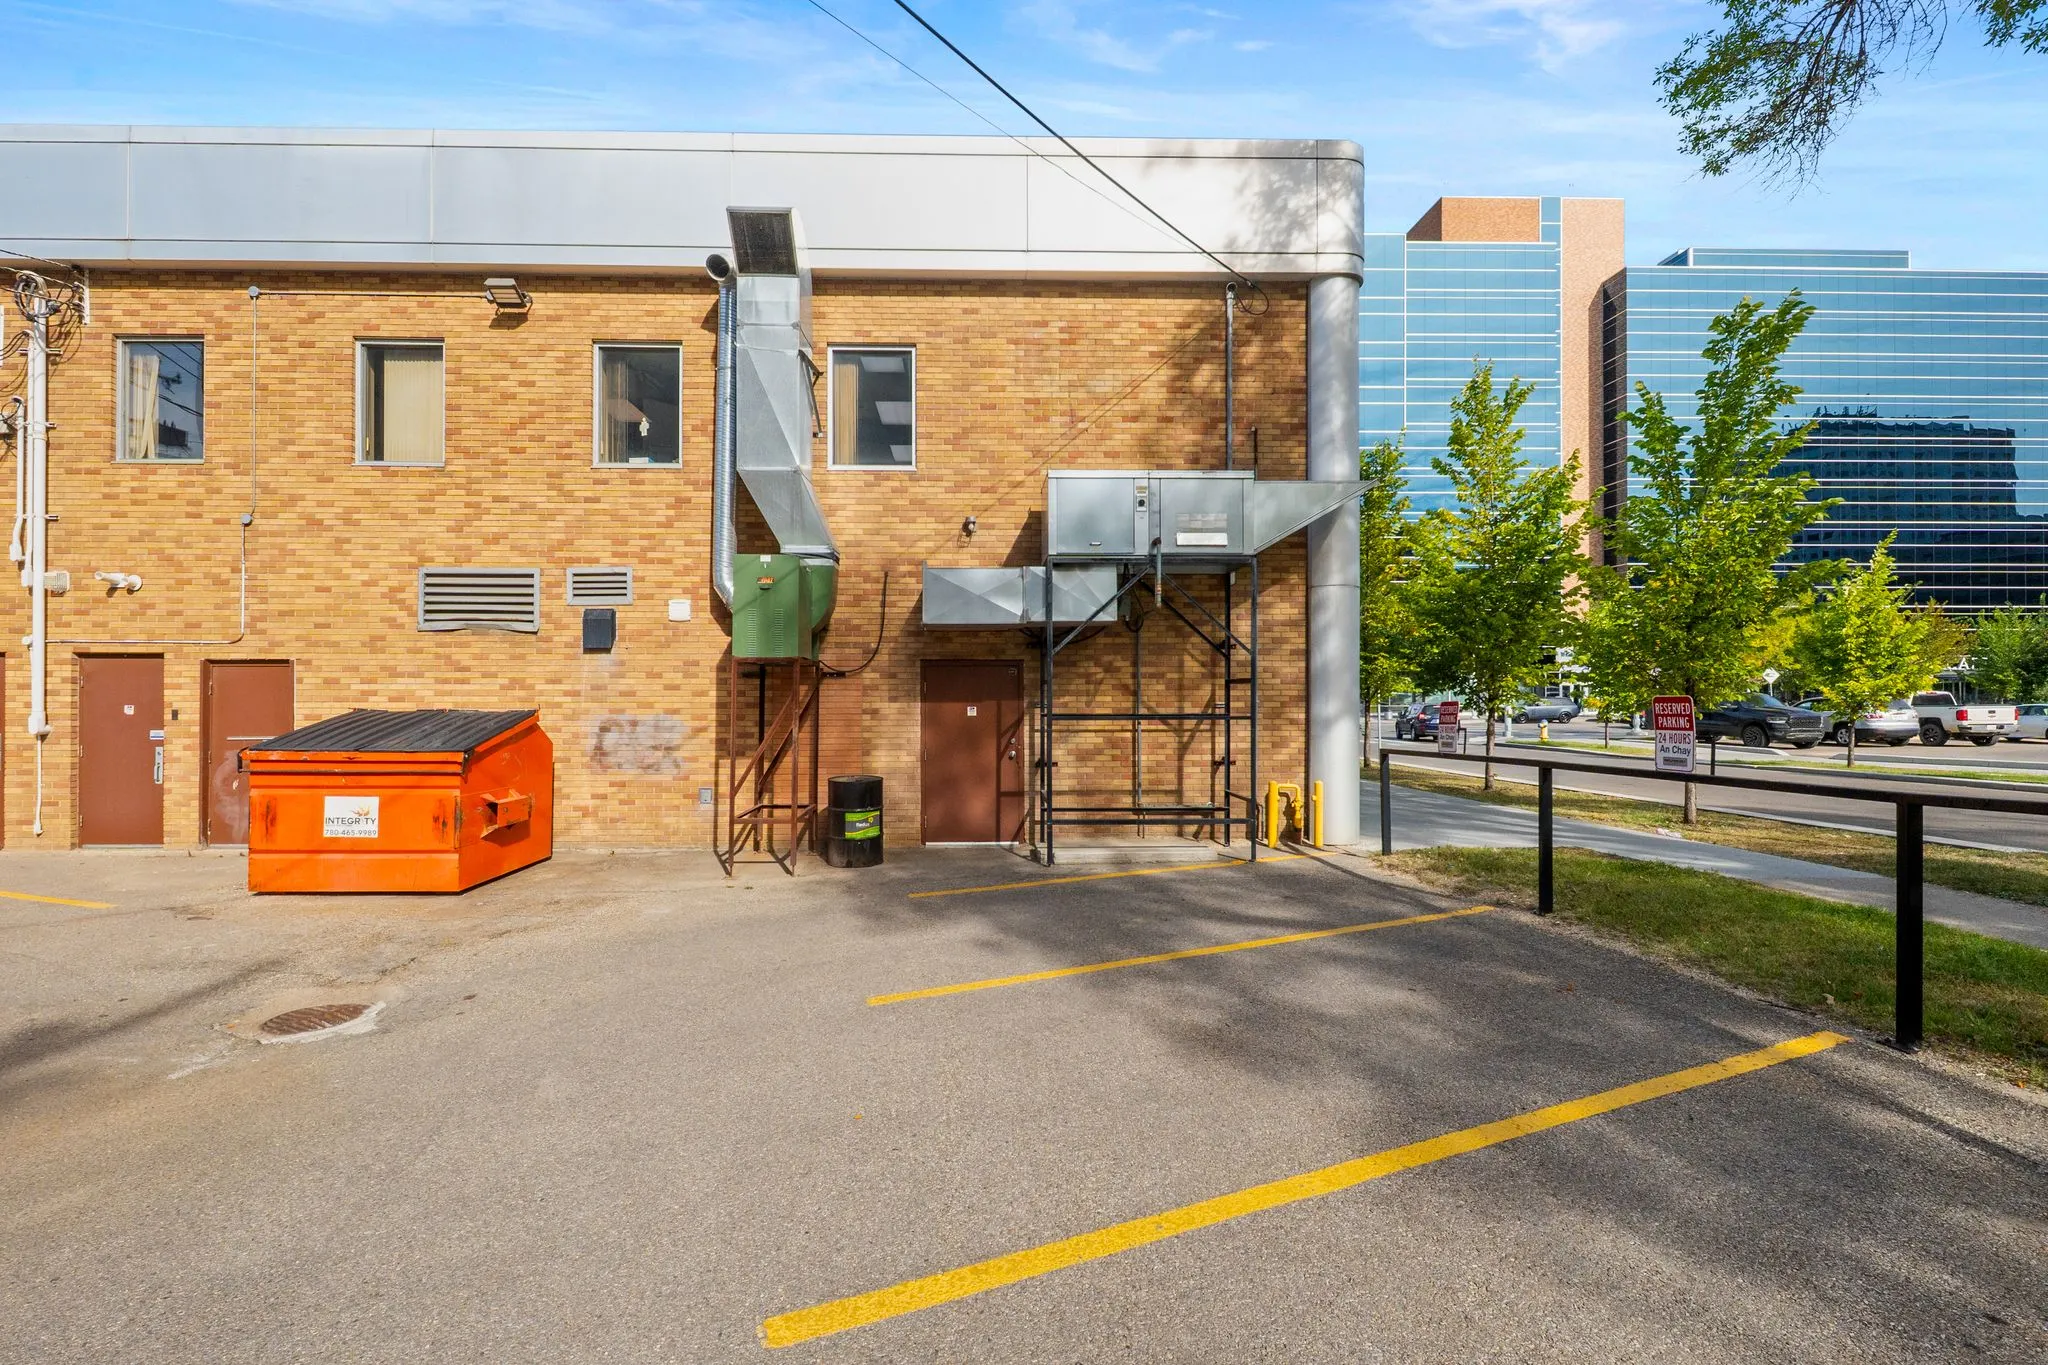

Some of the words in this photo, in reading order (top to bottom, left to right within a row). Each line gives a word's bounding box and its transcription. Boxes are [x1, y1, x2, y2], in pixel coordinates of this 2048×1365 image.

[1655, 703, 1690, 714] RESERVED
[1658, 717, 1689, 728] PARKING
[1658, 733, 1666, 744] 24
[1669, 733, 1691, 744] HOURS
[1660, 745, 1670, 753] An
[1672, 745, 1691, 757] Chay
[325, 817, 376, 825] INTEGRTY
